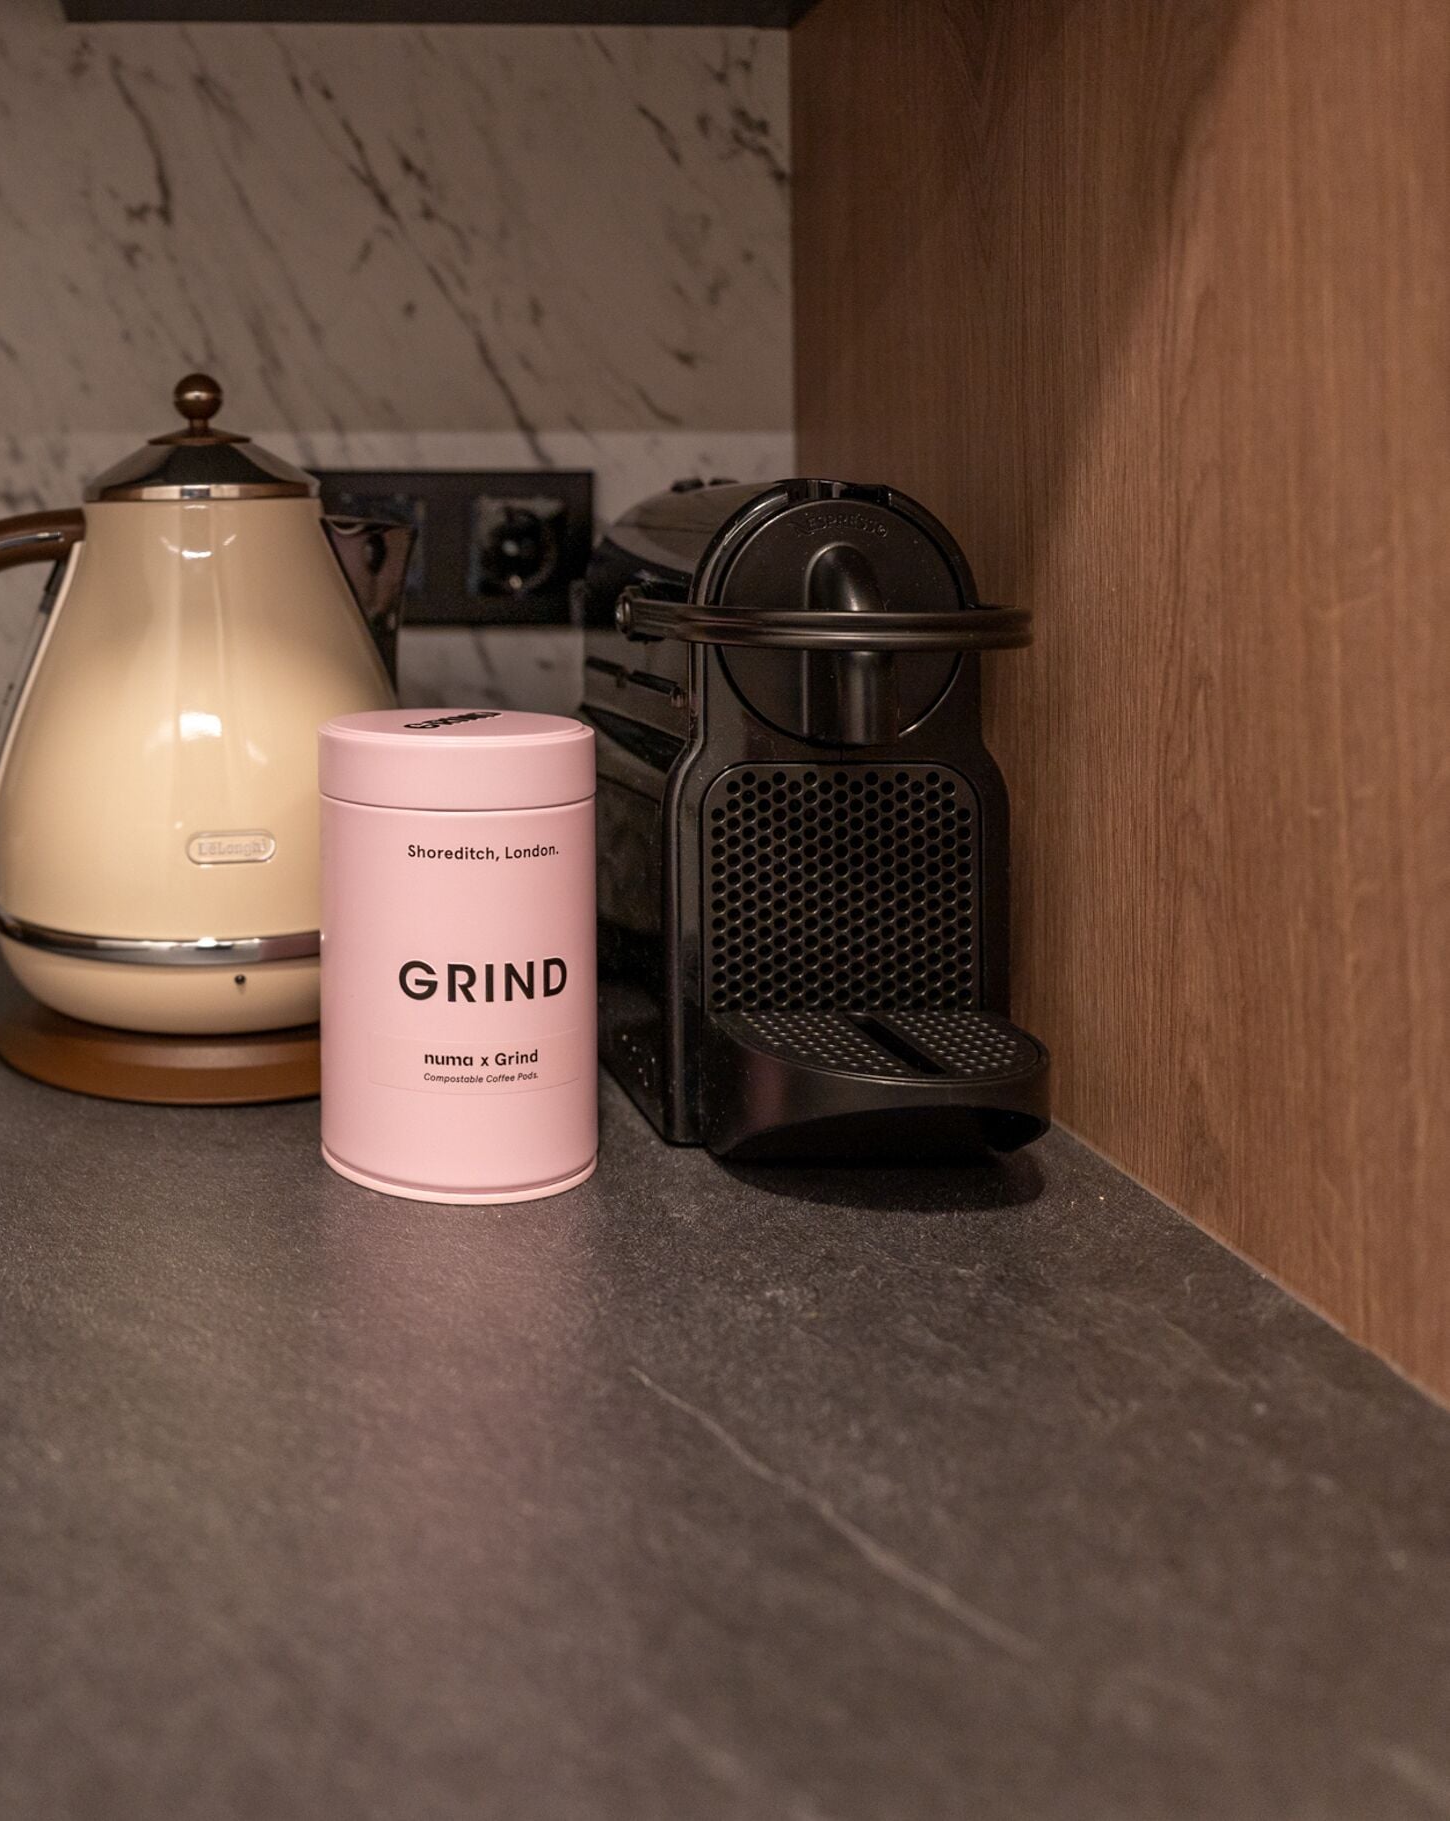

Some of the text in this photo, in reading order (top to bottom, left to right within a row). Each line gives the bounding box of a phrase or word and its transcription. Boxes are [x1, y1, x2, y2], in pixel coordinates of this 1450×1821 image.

[407, 844, 559, 862] Shoreditch, London.
[398, 957, 568, 1003] GRIND
[424, 1048, 539, 1067] numa x Grind
[423, 1071, 539, 1084] Compostable Coffee Pods.
